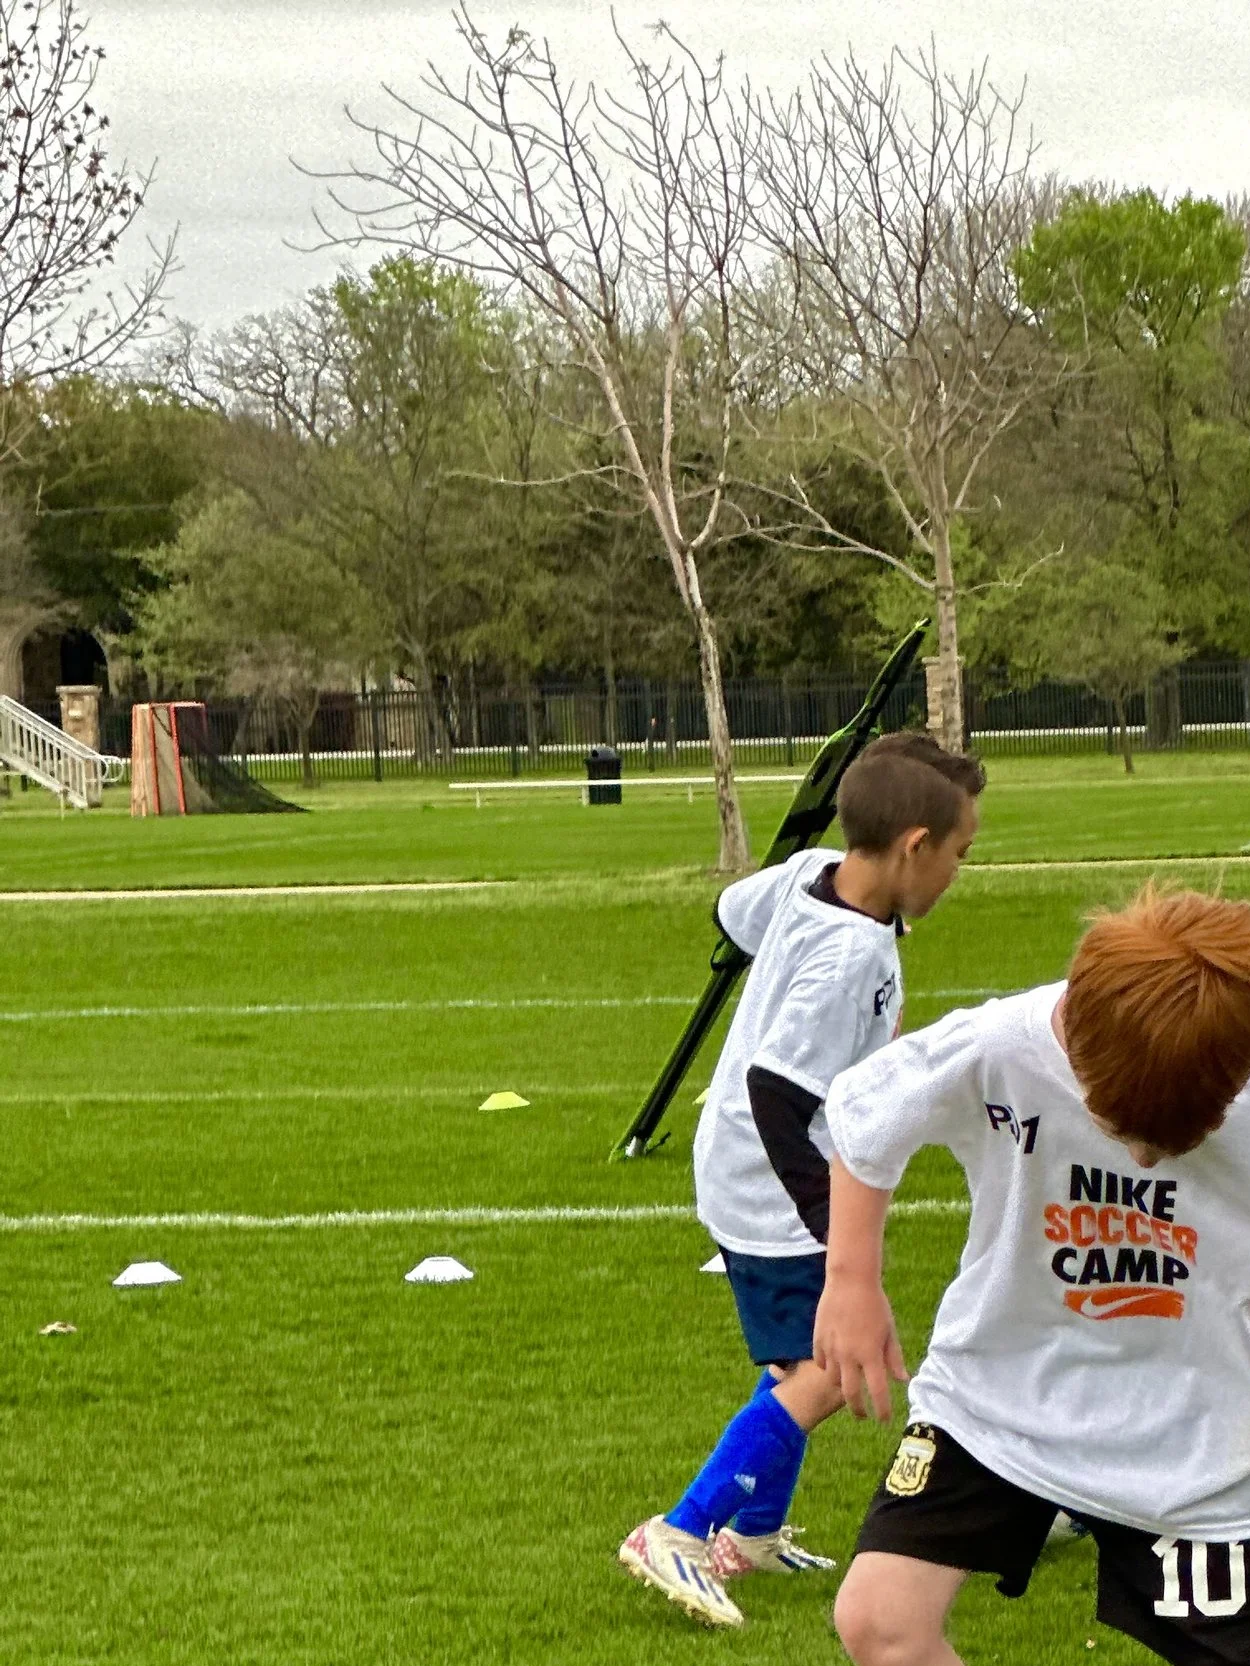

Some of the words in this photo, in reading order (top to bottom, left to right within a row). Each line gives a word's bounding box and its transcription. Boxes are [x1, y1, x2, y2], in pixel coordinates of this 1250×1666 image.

[1069, 1164, 1177, 1222] NIKE
[1044, 1203, 1198, 1265] SOCCER
[1051, 1247, 1190, 1285] CAMP
[1151, 1537, 1247, 1617] 10
